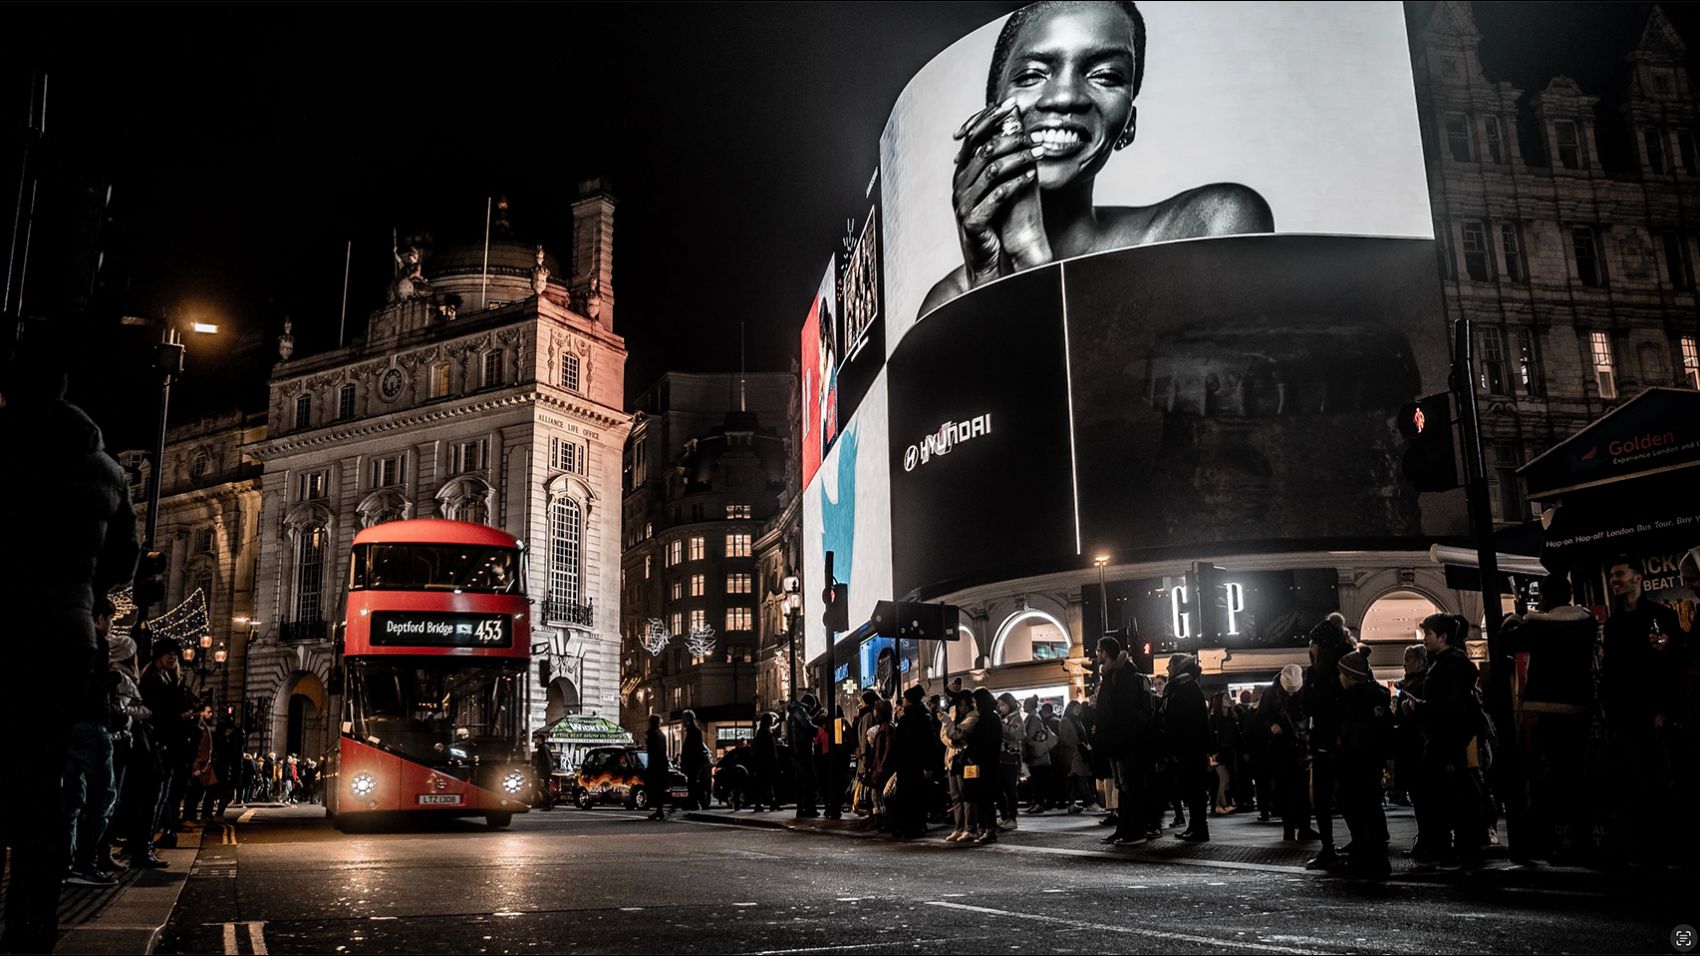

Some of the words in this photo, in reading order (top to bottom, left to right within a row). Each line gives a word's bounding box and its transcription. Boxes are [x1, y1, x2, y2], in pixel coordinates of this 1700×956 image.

[538, 414, 563, 428] ALLIANCE
[567, 423, 579, 434] LIFE
[583, 428, 600, 440] OFFICE
[920, 413, 991, 462] HYUNDAI
[1608, 431, 1674, 456] Golden
[1612, 452, 1651, 465] Experience
[1652, 446, 1679, 456] London
[1680, 441, 1695, 450] and
[1545, 538, 1573, 548] Hop-on
[1575, 531, 1604, 543] Hop-off
[1605, 527, 1634, 538] London
[1636, 523, 1652, 533] Bus
[1654, 520, 1674, 529] Tour.
[1676, 515, 1693, 526] Buy
[1643, 576, 1675, 592] BEAT
[1171, 582, 1244, 639] GP
[386, 620, 425, 636] Deptford
[427, 621, 454, 636] Bridge
[474, 620, 502, 640] 453
